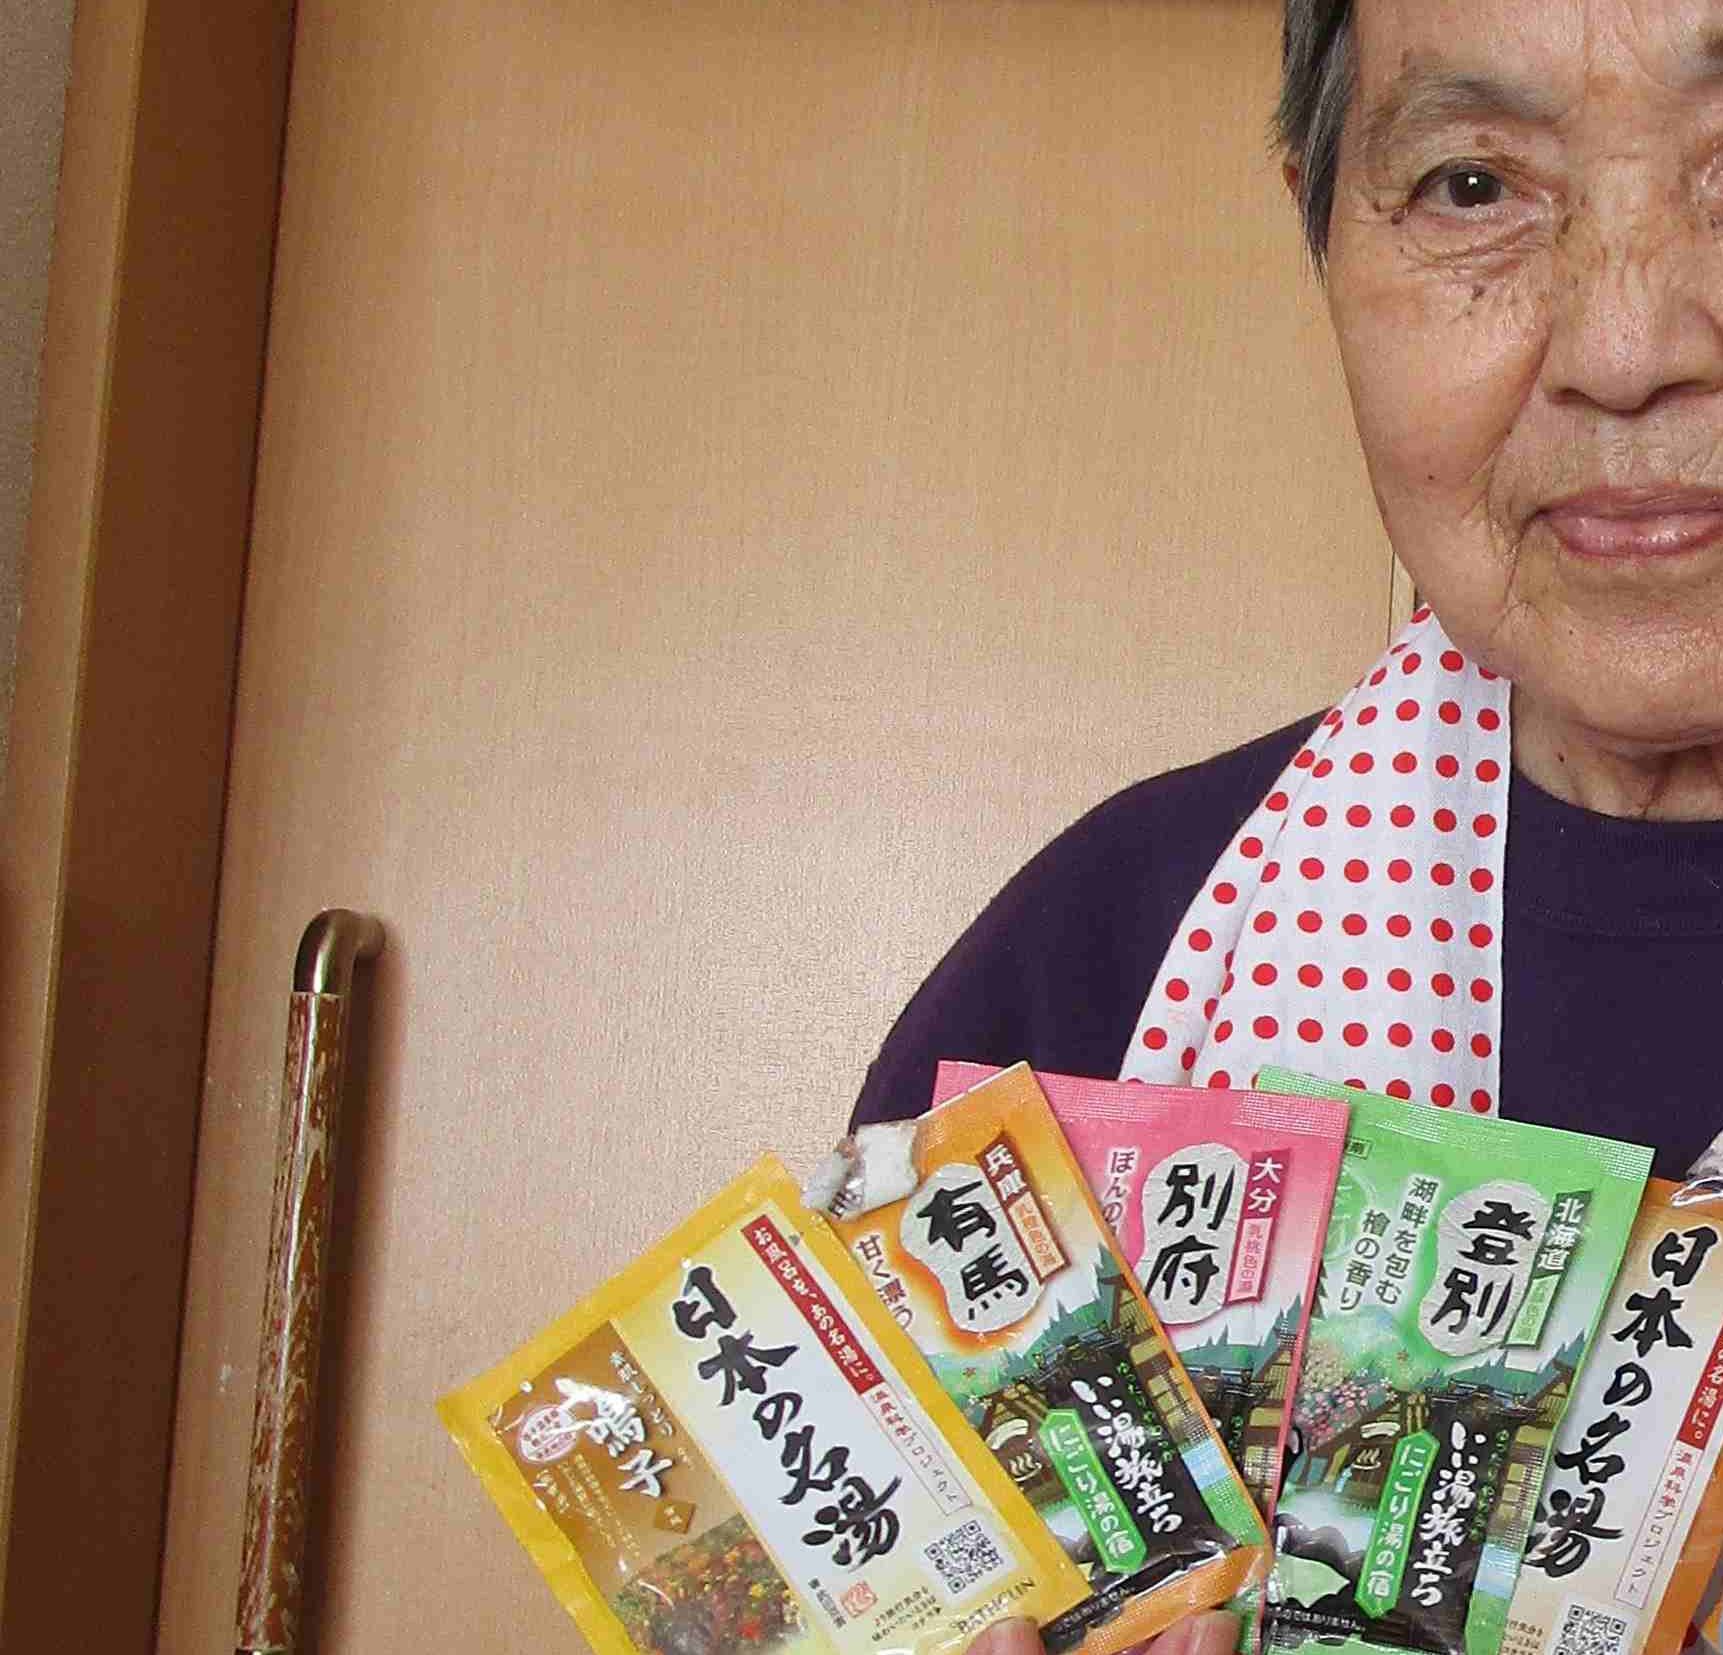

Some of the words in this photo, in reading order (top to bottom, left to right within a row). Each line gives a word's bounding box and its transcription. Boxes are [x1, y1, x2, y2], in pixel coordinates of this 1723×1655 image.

[916, 1180, 1030, 1322] 有馬
[1102, 1150, 1136, 1236] ほんの
[1145, 1163, 1236, 1306] 別府
[1247, 1156, 1284, 1214] 大分
[1375, 1176, 1439, 1305] 湖畔を包む
[1536, 1197, 1585, 1272] 北海道
[1340, 1209, 1391, 1311] 檜の香り
[1430, 1200, 1537, 1337] 登別
[672, 1266, 902, 1573] 日本の名湯
[1523, 1225, 1720, 1579] 日本の名湯
[1367, 1444, 1427, 1597] にごり湯の宿
[1410, 1420, 1477, 1607] いい湯旅立ち
